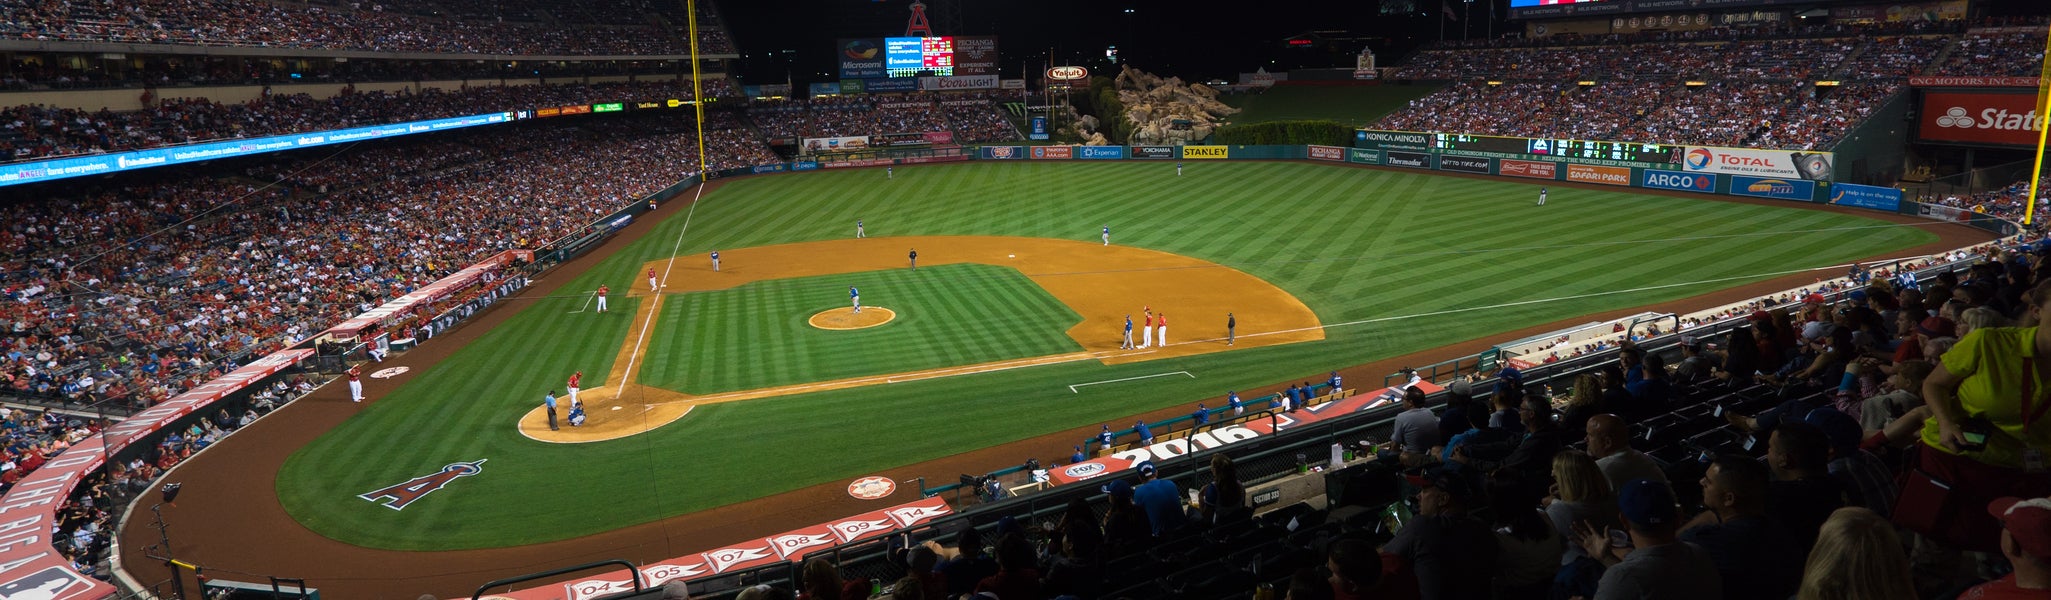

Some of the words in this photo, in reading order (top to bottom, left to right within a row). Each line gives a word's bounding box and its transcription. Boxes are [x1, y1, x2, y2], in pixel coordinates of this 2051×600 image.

[1749, 11, 1780, 23] Morgan
[843, 61, 882, 69] Microsemi
[938, 76, 968, 88] Coors
[969, 78, 994, 87] LIGHT
[1910, 77, 1933, 86] CNC
[1989, 77, 2011, 86] INC.
[1366, 133, 1393, 141] KONICA
[1394, 134, 1426, 143] MINOLTA
[1094, 149, 1119, 157] Experian
[1184, 148, 1226, 156] STANLEY
[1388, 157, 1422, 166] Thermador
[1718, 153, 1775, 167] TOTAL
[47, 167, 64, 176] fans
[65, 162, 109, 175] everywhere.
[1570, 171, 1601, 180] SAFARI
[1602, 173, 1627, 182] PARK
[1647, 173, 1693, 188] ARCO
[1845, 189, 1859, 197] Help
[1073, 464, 1099, 475] FOX
[357, 458, 488, 511] A
[0, 471, 76, 513] THE
